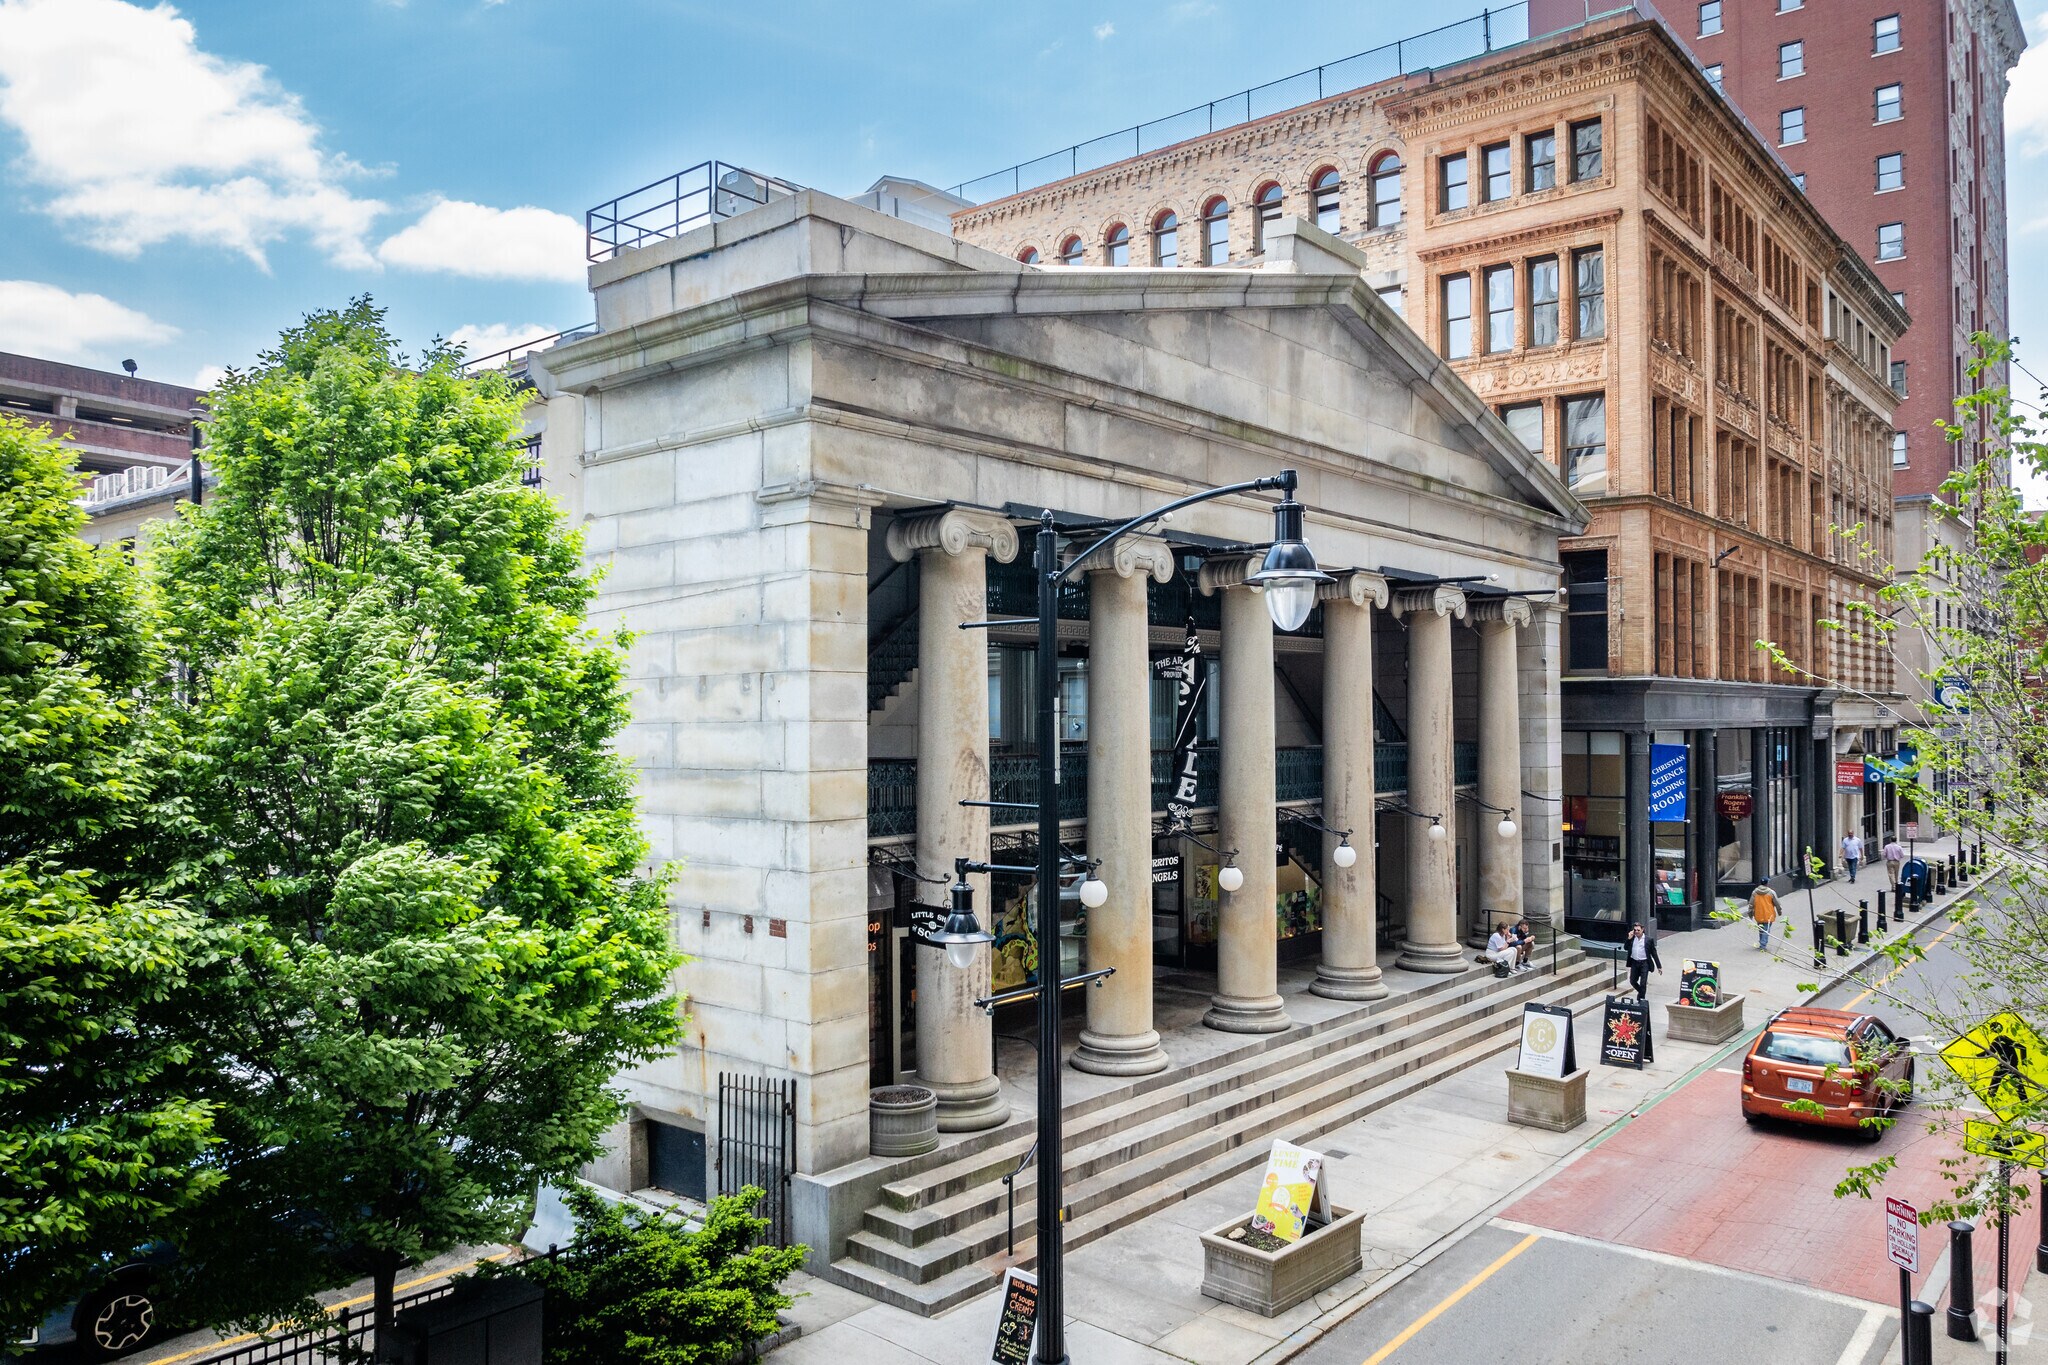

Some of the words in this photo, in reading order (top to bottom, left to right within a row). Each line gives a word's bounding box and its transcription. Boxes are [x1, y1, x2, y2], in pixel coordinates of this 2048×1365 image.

[1154, 657, 1171, 670] THE
[1651, 754, 1685, 775] CHRISTIAN
[1651, 766, 1685, 788] SCIENCE
[1652, 778, 1685, 800] READING
[1651, 790, 1685, 813] ROOM
[1152, 856, 1179, 867] RRITOS
[1152, 870, 1178, 883] NGELS
[911, 911, 935, 919] LITTLE
[917, 927, 935, 939] SO
[1610, 1049, 1637, 1060] OPEN
[1273, 1149, 1300, 1158] LUNCH
[1273, 1158, 1298, 1169] TIME
[1887, 1200, 1916, 1222] WARNING
[1896, 1218, 1907, 1230] NO
[1888, 1224, 1916, 1244] PARKING
[1888, 1234, 1896, 1242] ON
[1897, 1239, 1916, 1251] HOLLOW
[1891, 1242, 1914, 1258] SIDEWALK
[1011, 1278, 1025, 1290] little
[1010, 1291, 1019, 1300] of
[1018, 1294, 1035, 1307] soups
[1009, 1300, 1035, 1316] CREAMY
